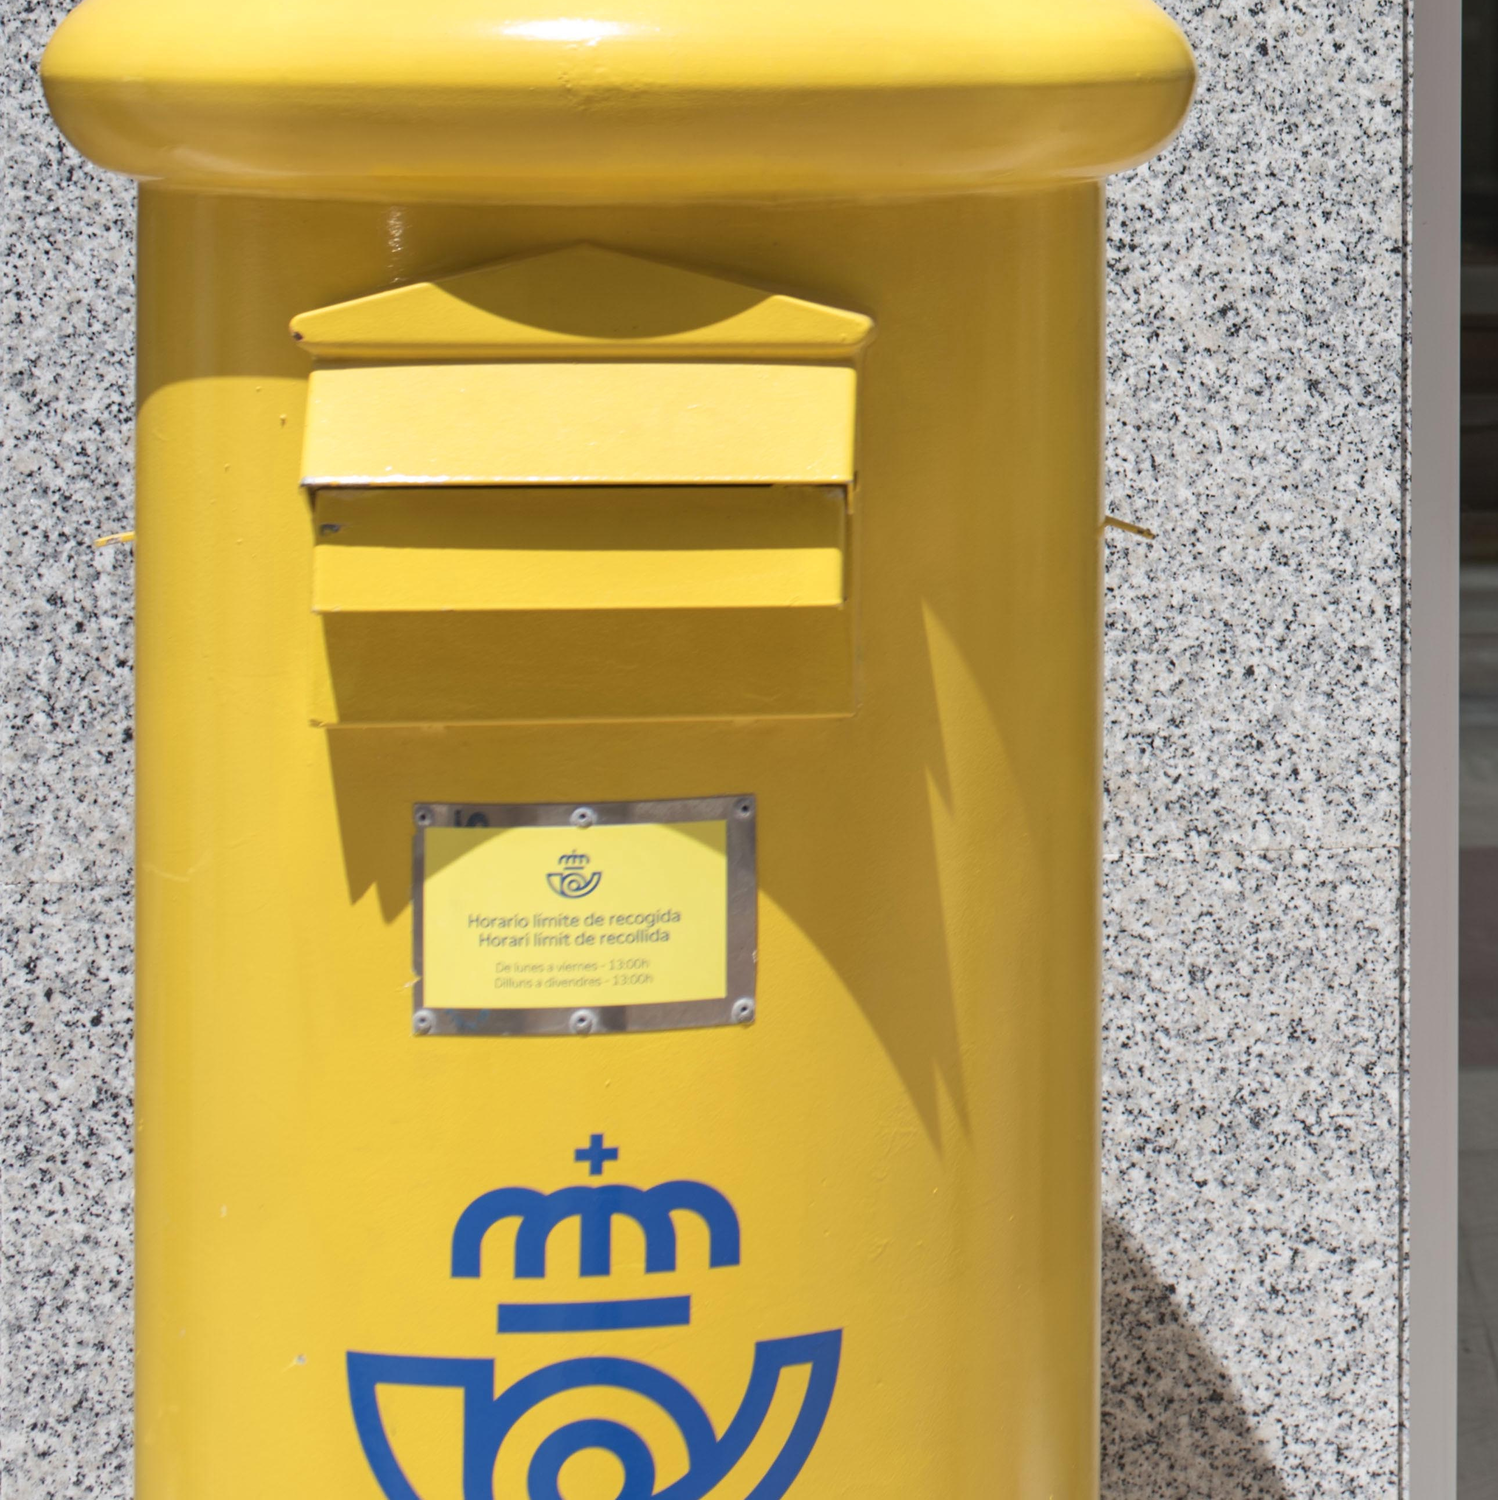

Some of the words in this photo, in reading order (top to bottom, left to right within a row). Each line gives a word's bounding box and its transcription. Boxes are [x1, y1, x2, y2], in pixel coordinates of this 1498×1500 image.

[468, 912, 529, 929] Horario
[584, 913, 605, 927] de
[610, 908, 681, 928] recogida
[479, 933, 530, 947] Horari
[575, 931, 595, 946] de
[600, 928, 670, 945] recollida
[496, 963, 511, 973] De
[514, 961, 544, 972] lunes
[546, 964, 554, 972] a
[556, 960, 598, 972] viernes
[609, 959, 649, 971] 13:00h
[494, 977, 532, 989] Dilluns
[535, 980, 542, 988] a
[545, 976, 601, 988] divendres
[612, 974, 654, 985] 13:00h
